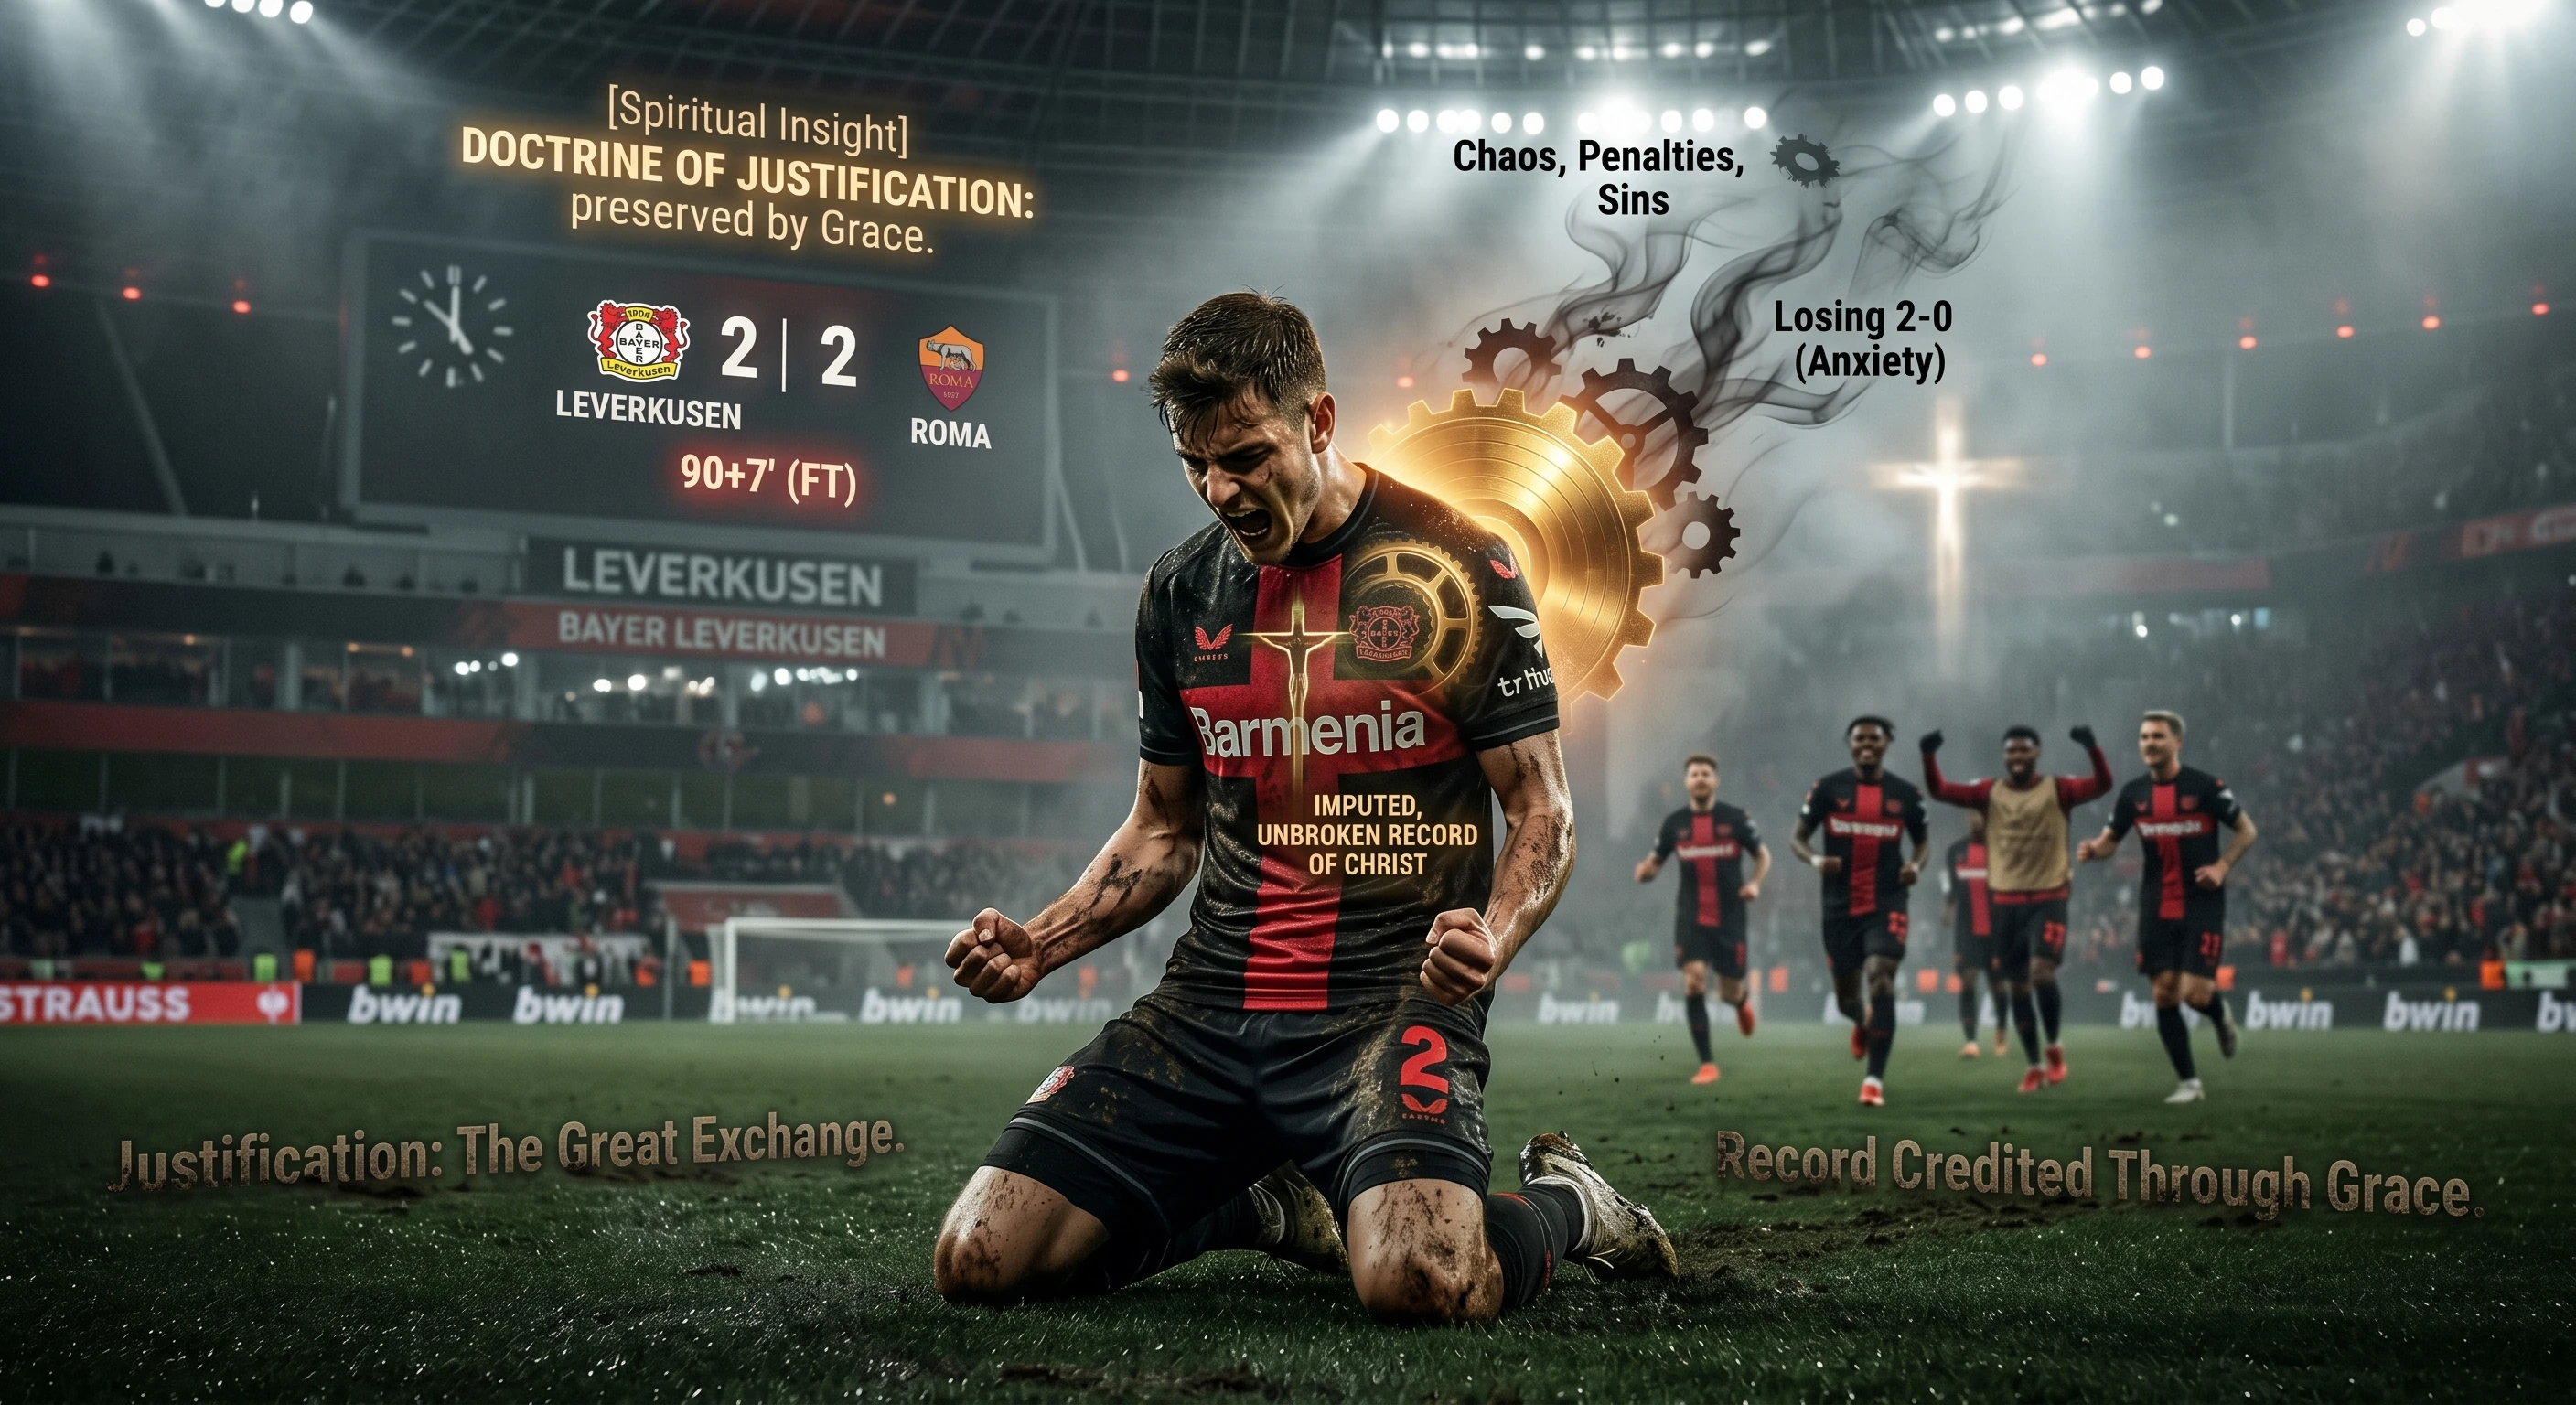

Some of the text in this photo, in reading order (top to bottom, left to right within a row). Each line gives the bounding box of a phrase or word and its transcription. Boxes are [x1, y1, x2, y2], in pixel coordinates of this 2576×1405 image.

[619, 338, 660, 348] BAYER
[721, 316, 858, 388] 2 2
[607, 360, 671, 377] Leverkusen
[928, 373, 974, 389] ROMA
[556, 389, 742, 430] LEVERKUSEN
[911, 417, 993, 449] ROMA
[681, 454, 856, 508] 90+7' (FT)
[563, 547, 883, 607] LEVERKUSEN
[558, 611, 886, 658] BAYER LEVERKUSEN
[1189, 700, 1426, 758] Barmenia
[347, 983, 462, 1024] bwin
[512, 983, 624, 1024] bwin
[860, 986, 961, 1024] bwin
[1538, 992, 1619, 1024] bwin
[2245, 988, 2333, 1029] bwin
[2383, 987, 2481, 1031] bwin
[1401, 1025, 1449, 1094] 2
